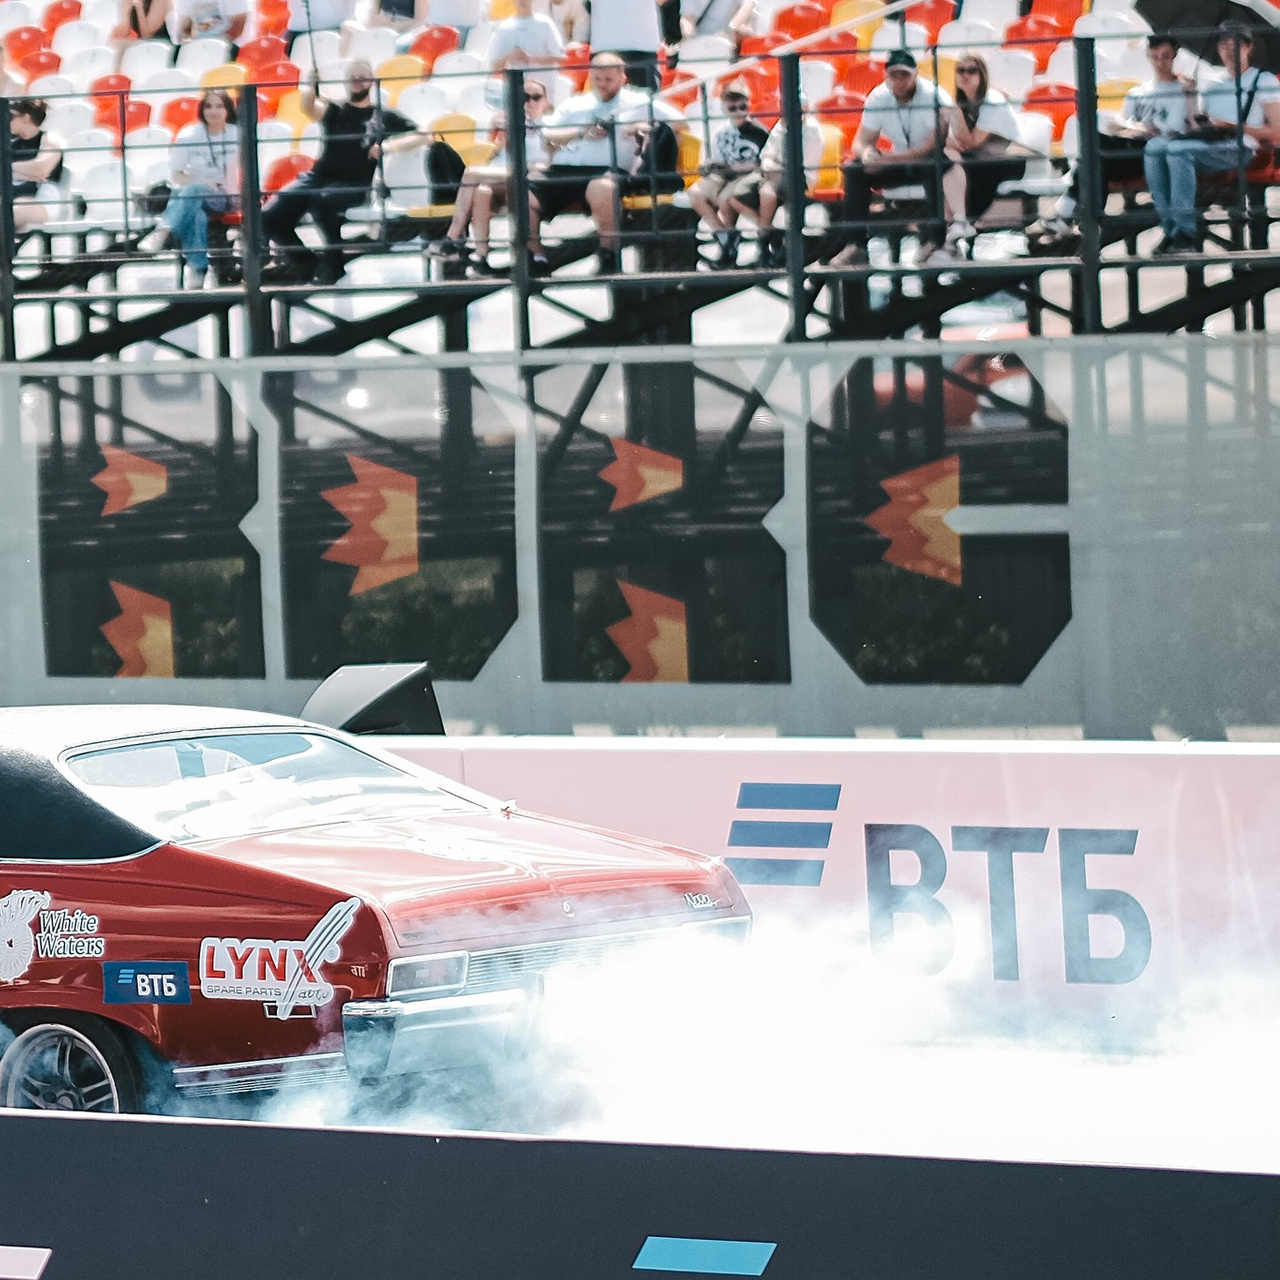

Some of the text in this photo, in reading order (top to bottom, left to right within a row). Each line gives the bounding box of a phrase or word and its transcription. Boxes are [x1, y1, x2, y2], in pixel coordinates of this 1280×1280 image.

[864, 823, 1153, 986] ВТБ
[40, 910, 98, 934] White
[37, 934, 104, 957] Waters
[205, 945, 319, 984] LYNX
[136, 973, 177, 997] ВТБ
[206, 984, 282, 996] SPARE PARTS
